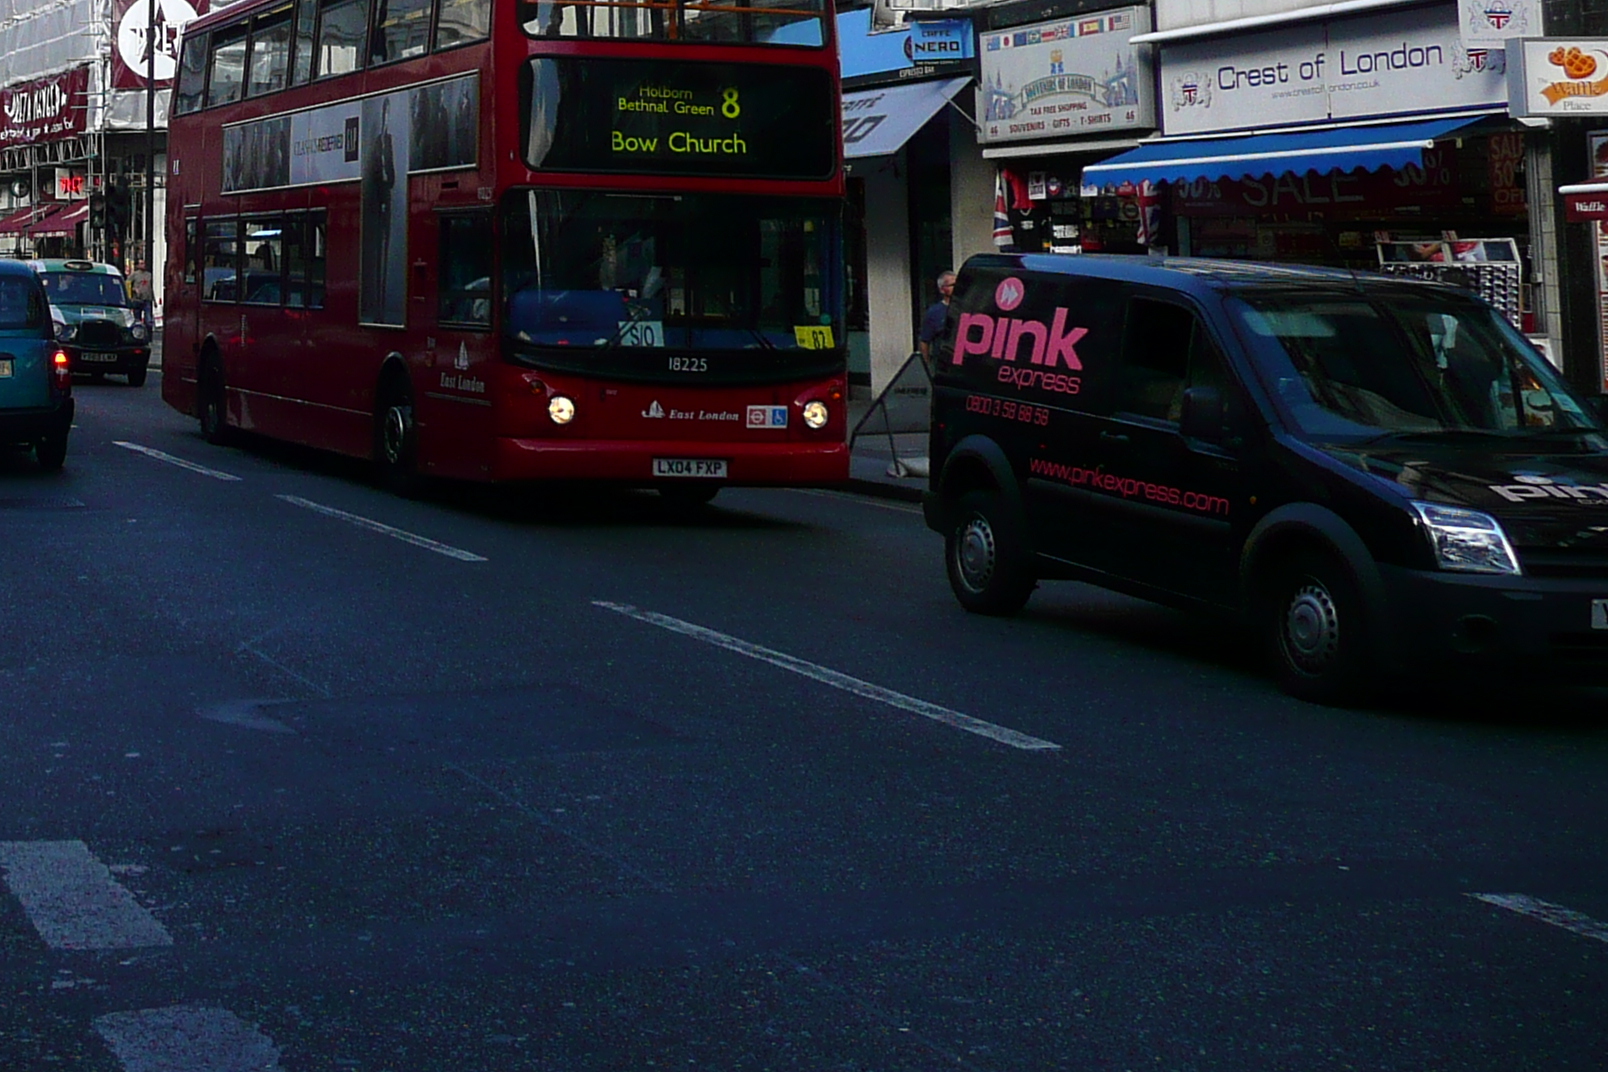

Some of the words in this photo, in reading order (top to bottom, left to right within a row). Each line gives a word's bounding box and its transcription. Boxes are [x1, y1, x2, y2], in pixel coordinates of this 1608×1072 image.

[914, 41, 960, 53] NERO
[924, 65, 935, 75] BAR
[1217, 62, 1288, 91] Crest
[1299, 53, 1325, 81] of
[1340, 41, 1443, 76] London
[1553, 80, 1602, 97] Waffle
[617, 97, 669, 113] Bethnal
[674, 101, 715, 116] Green
[639, 85, 694, 100] Holborn
[721, 86, 741, 119] 8
[1030, 106, 1042, 116] TAX
[1043, 104, 1057, 115] FREE
[1057, 102, 1088, 114] SHOPPING
[1562, 100, 1592, 111] Place
[1008, 120, 1046, 135] SOUVENIRS
[1052, 117, 1071, 129] GIFTS
[1080, 112, 1112, 126] T-SHIRTS
[611, 130, 659, 152] Bow
[668, 131, 748, 154] Church
[1242, 175, 1365, 207] SALE
[1575, 200, 1606, 213] Waffle
[952, 276, 1091, 372] pink
[668, 356, 708, 373] 18225
[440, 371, 456, 389] East
[457, 374, 486, 394] London
[997, 364, 1083, 396] express
[668, 408, 695, 421] East
[698, 409, 739, 422] London
[657, 460, 693, 475] LX04
[696, 460, 722, 475] FXP
[1028, 456, 1231, 517] www.pinkexpress.com
